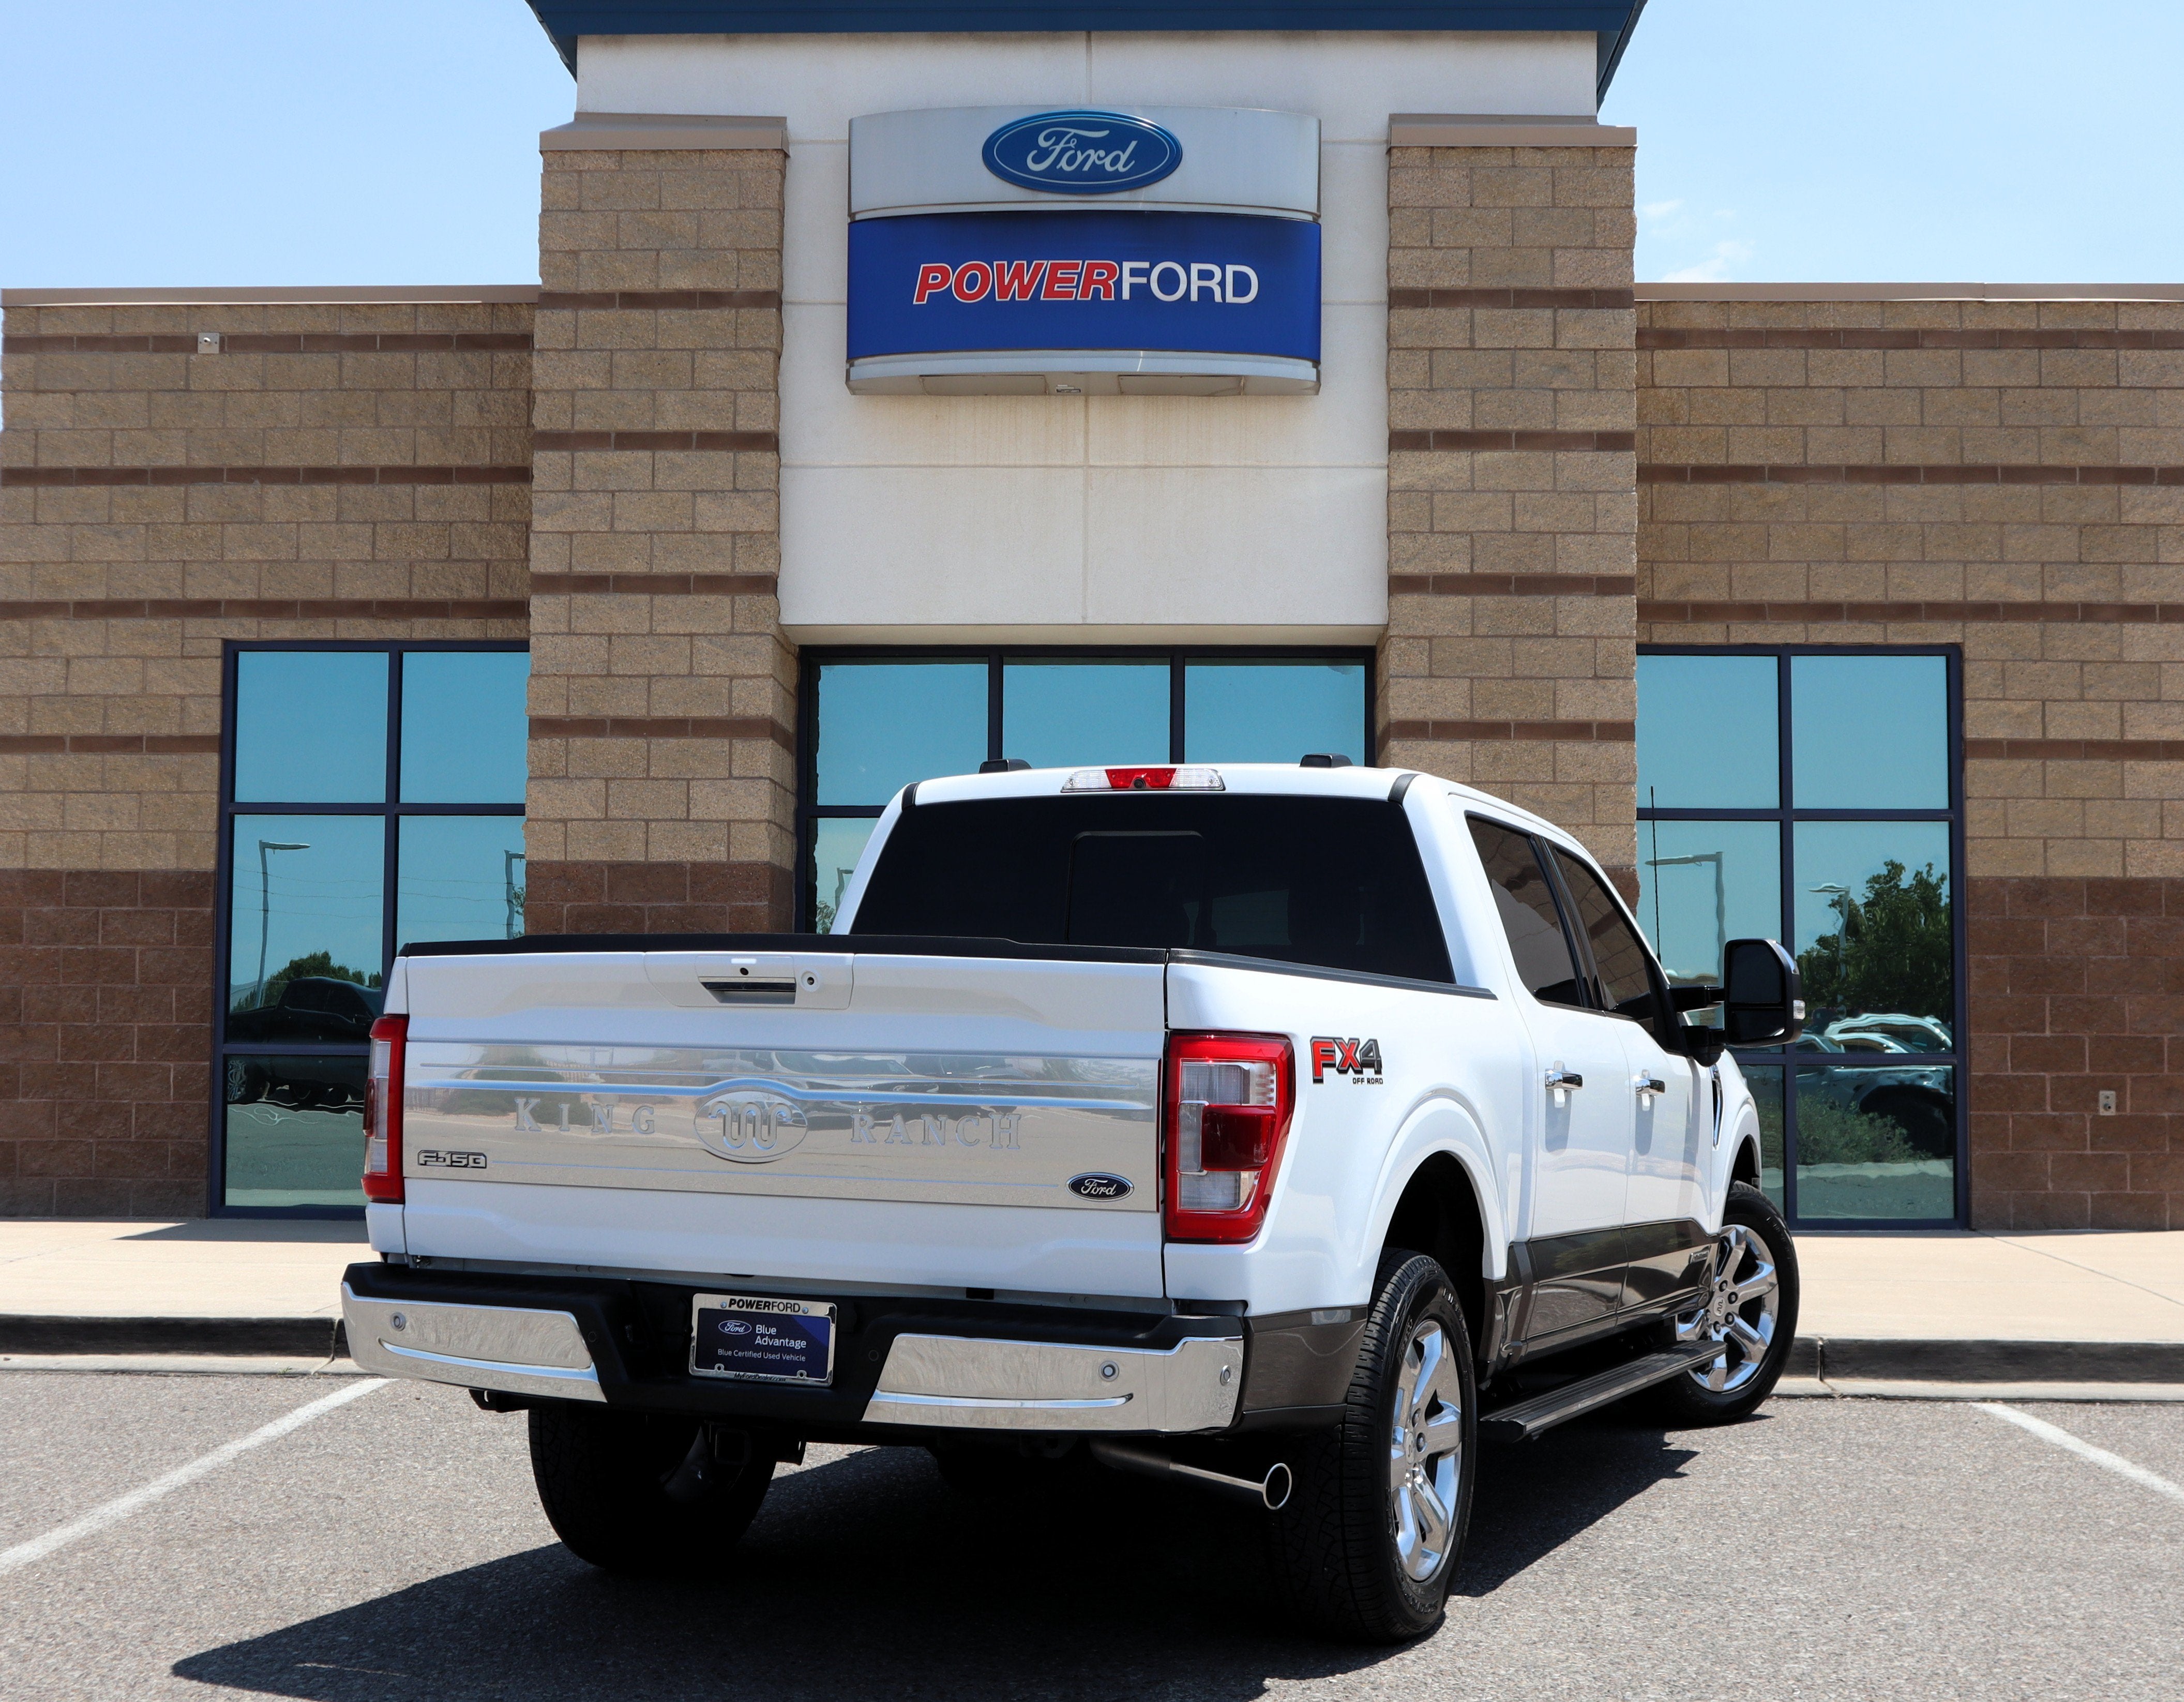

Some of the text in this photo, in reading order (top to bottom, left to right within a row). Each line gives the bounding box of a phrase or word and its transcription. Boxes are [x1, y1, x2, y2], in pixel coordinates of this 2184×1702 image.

[1026, 127, 1137, 173] Ford
[1309, 1035, 1382, 1085] FX4
[515, 1097, 1021, 1150] KING RANCH
[1081, 1178, 1117, 1195] Ford
[728, 1298, 801, 1313] POWERFORD
[725, 1322, 745, 1333] Ford
[756, 1324, 776, 1335] Blue
[755, 1335, 807, 1349] Advantage
[733, 1350, 762, 1359] Certified
[781, 1353, 806, 1362] Vehicle
